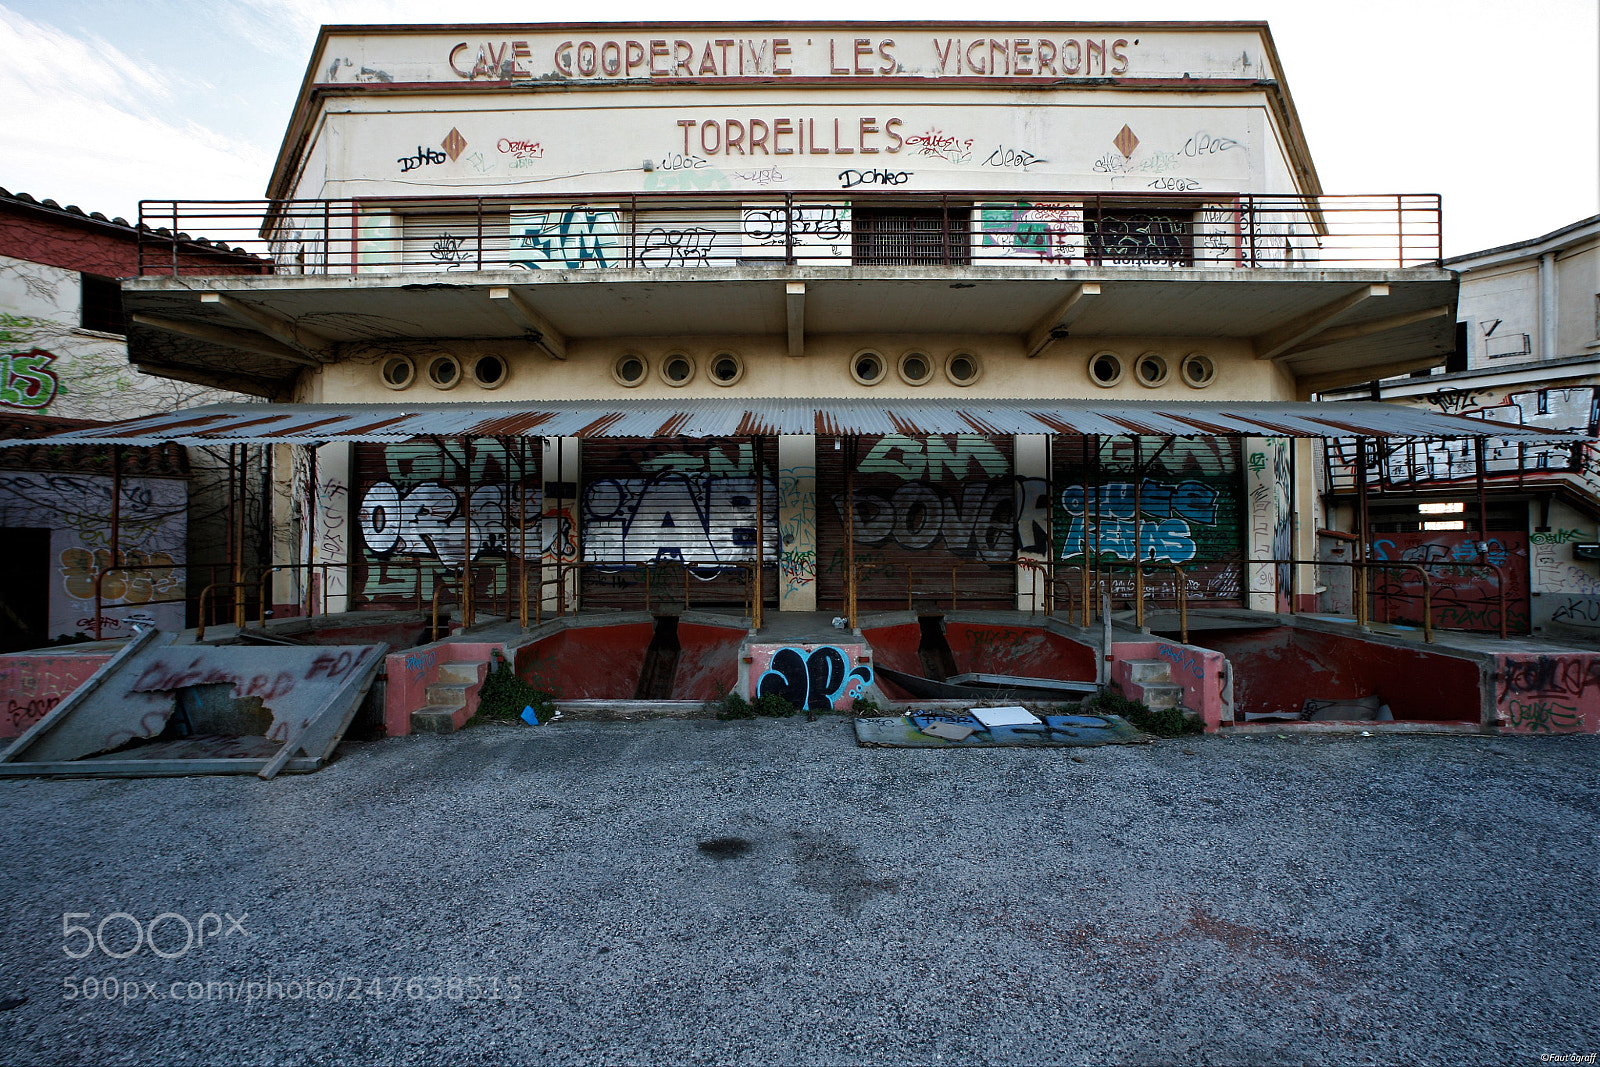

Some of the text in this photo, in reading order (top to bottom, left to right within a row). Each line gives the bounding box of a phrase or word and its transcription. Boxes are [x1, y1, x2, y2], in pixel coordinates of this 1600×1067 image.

[449, 41, 532, 78] CAVE
[555, 38, 792, 77] COOPERATIVE
[677, 118, 903, 156] TORREILLES
